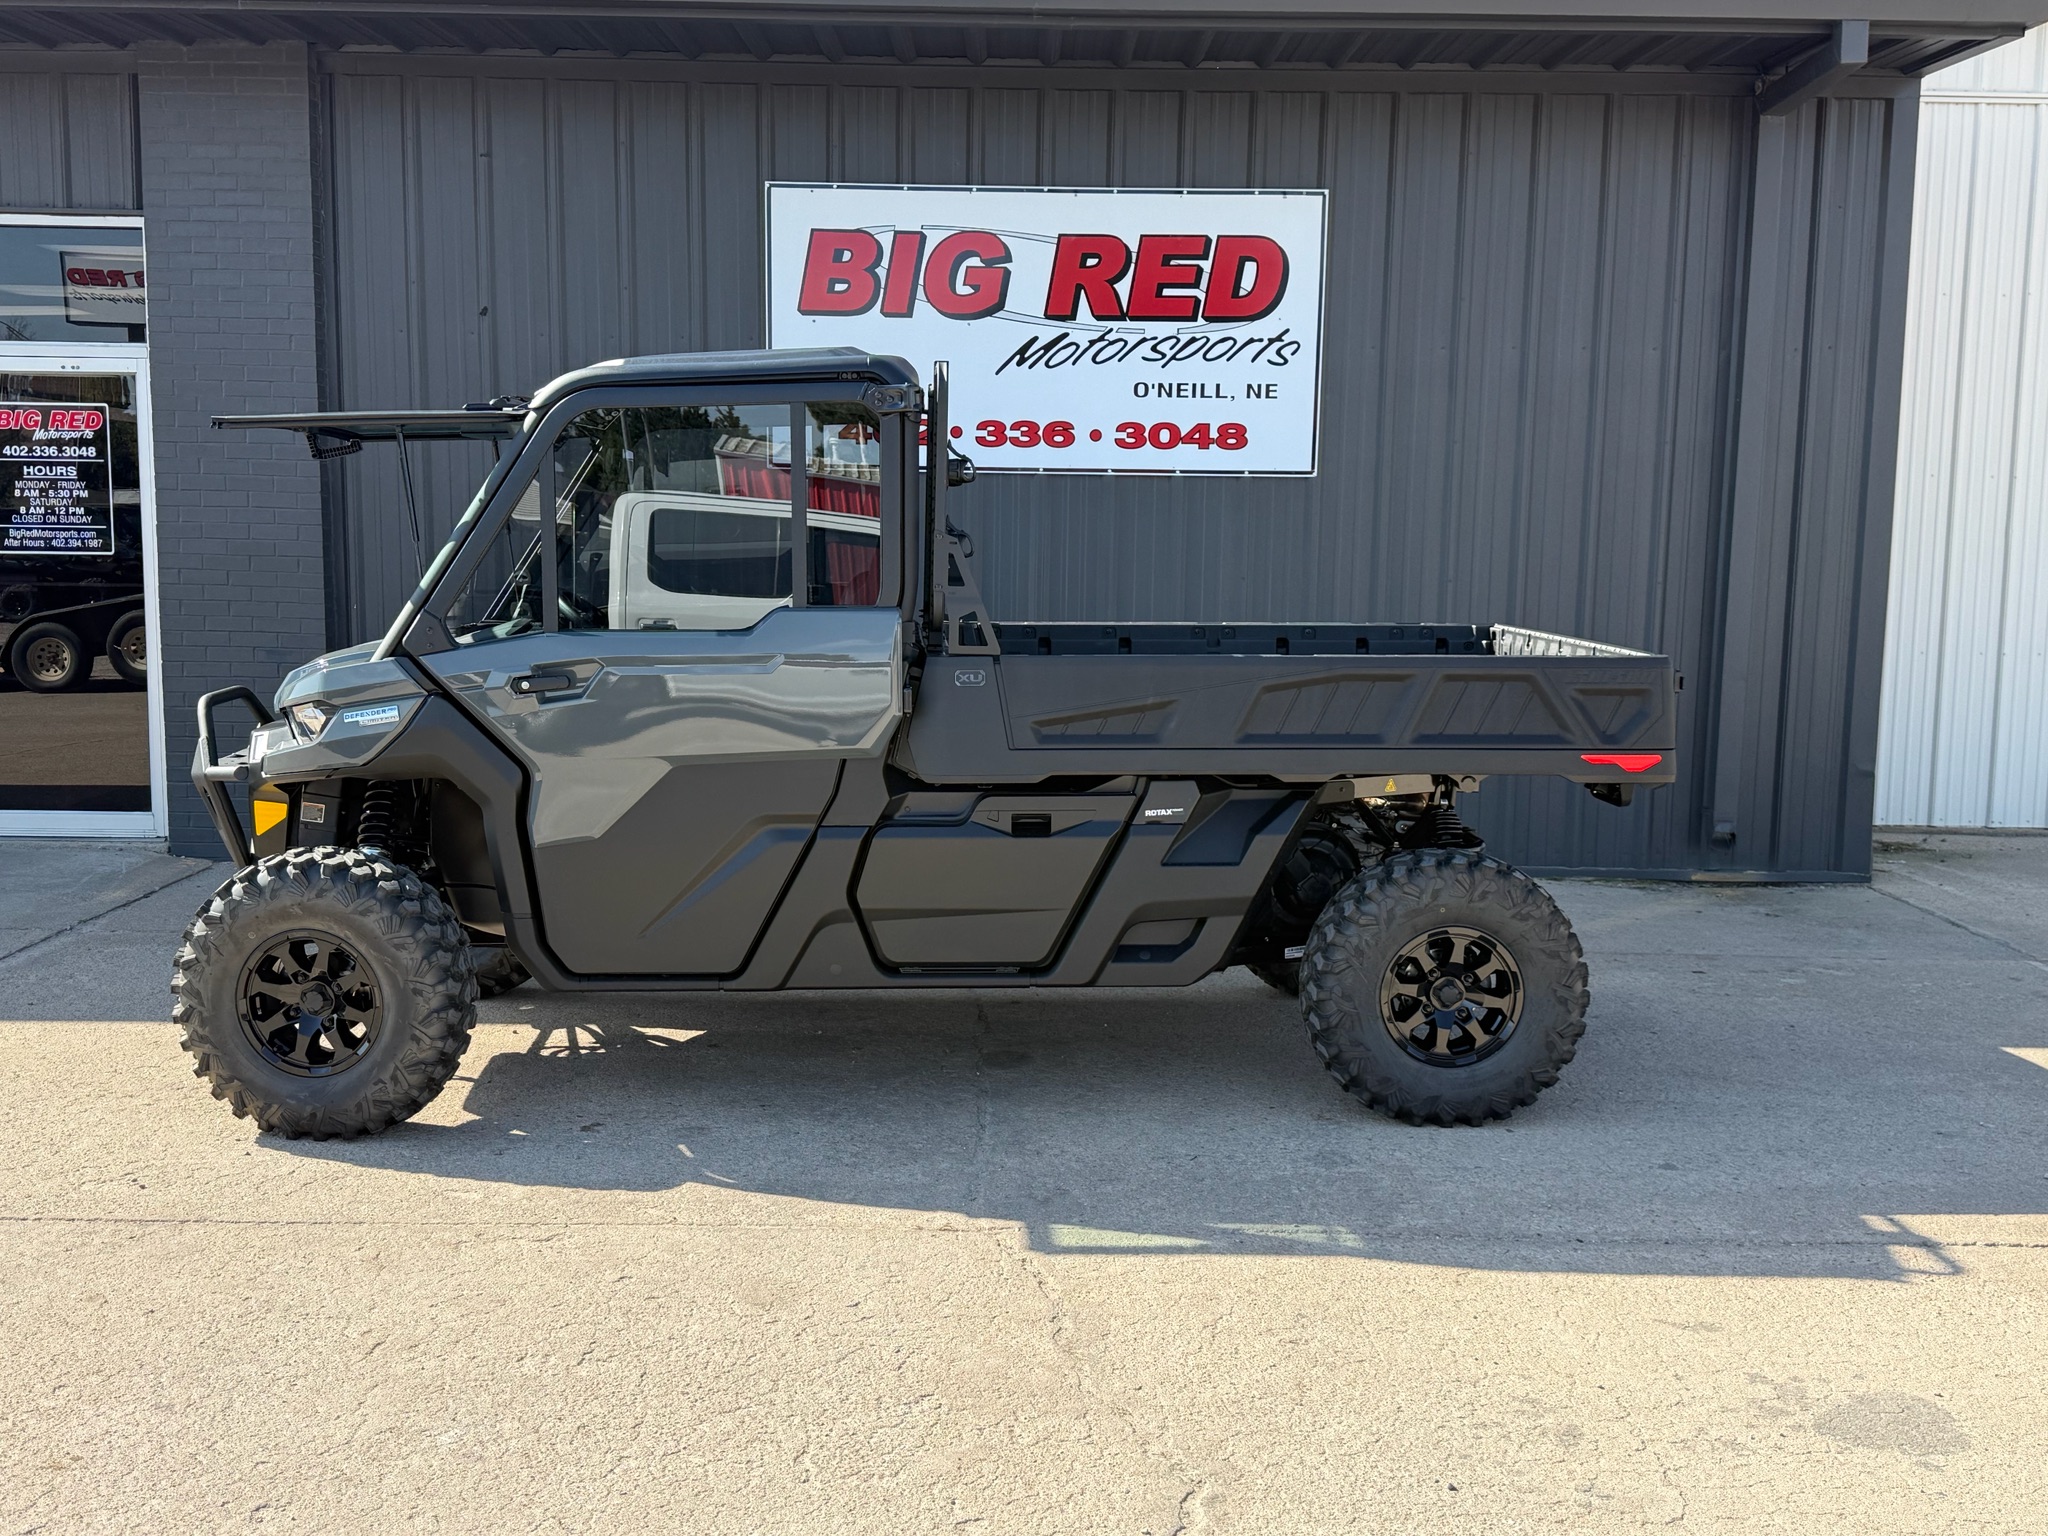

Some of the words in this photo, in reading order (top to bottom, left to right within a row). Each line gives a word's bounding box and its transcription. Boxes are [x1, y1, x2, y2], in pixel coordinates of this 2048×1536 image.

[798, 227, 1013, 320] BIG
[1044, 233, 1290, 323] RED
[995, 327, 1301, 375] Motorsports
[1133, 382, 1236, 401] O'NEILL,
[1246, 383, 1279, 399] NE
[0, 409, 42, 430] BIG
[48, 410, 104, 431] RED
[32, 428, 95, 441] Motorsports
[975, 420, 1076, 448] 336
[1114, 422, 1249, 450] 3048
[2, 445, 97, 458] 402.336.3048
[23, 465, 78, 476] HOURS
[15, 480, 50, 489] MONDAY
[57, 481, 87, 489] FRIDAY
[14, 489, 21, 497] 8
[23, 489, 40, 497] AM
[48, 489, 70, 498] 5:30
[72, 490, 89, 498] PM
[29, 497, 73, 506] SATURDAY
[20, 506, 26, 514] 8
[28, 506, 45, 514] AM
[69, 507, 85, 515] PM
[12, 514, 44, 523] CLOSED
[46, 515, 58, 523] ON
[59, 515, 93, 523] SUNDAY
[9, 528, 97, 539] BigRedMotorsports.com
[4, 538, 21, 547] After
[23, 538, 45, 547] Hours
[51, 538, 103, 548] 402.394.1987
[345, 709, 386, 720] DEFENDER
[1144, 808, 1173, 817] ROTAX
